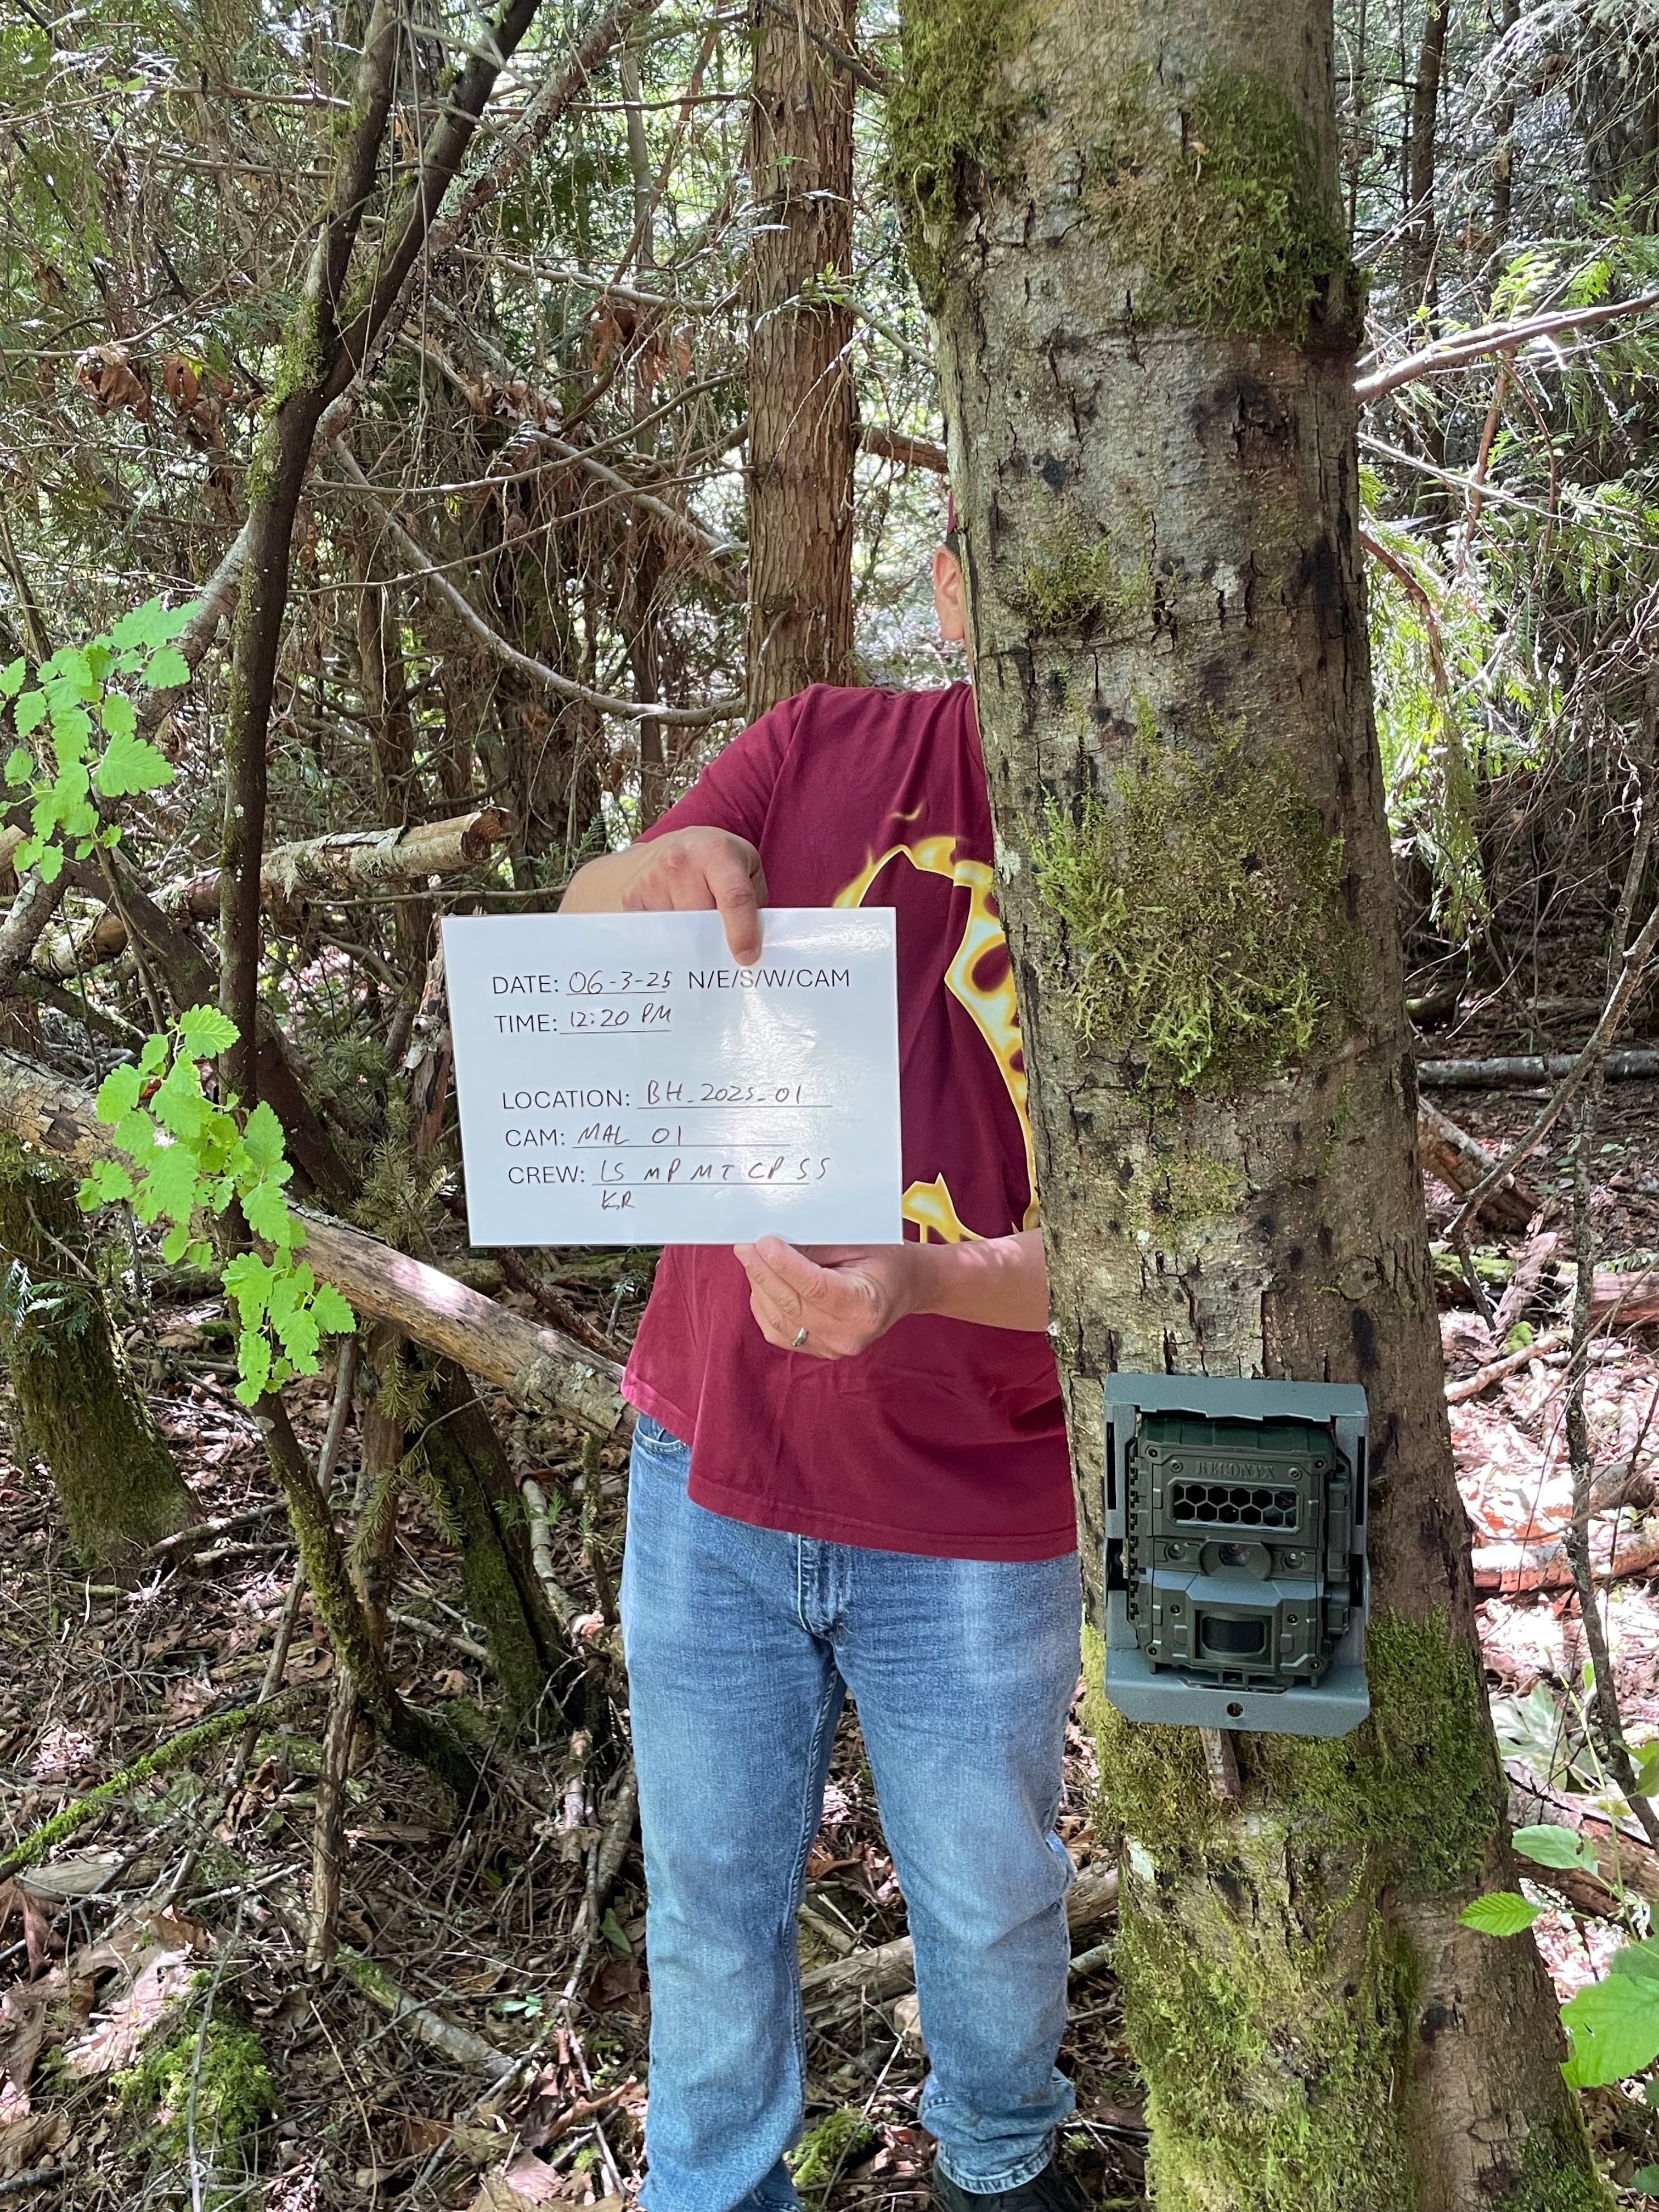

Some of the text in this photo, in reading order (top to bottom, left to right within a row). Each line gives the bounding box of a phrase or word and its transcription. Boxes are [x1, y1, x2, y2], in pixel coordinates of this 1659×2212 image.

[493, 969, 849, 994] DATE: 06-3-25 N/E/S/W/CAM
[494, 1002, 672, 1033] TIME: 12:20 PM
[503, 1089, 630, 1109] LOCATION:
[505, 1122, 681, 1147] CAM: MAL 01
[509, 1166, 585, 1184] CREW:
[748, 1156, 784, 1180] CP
